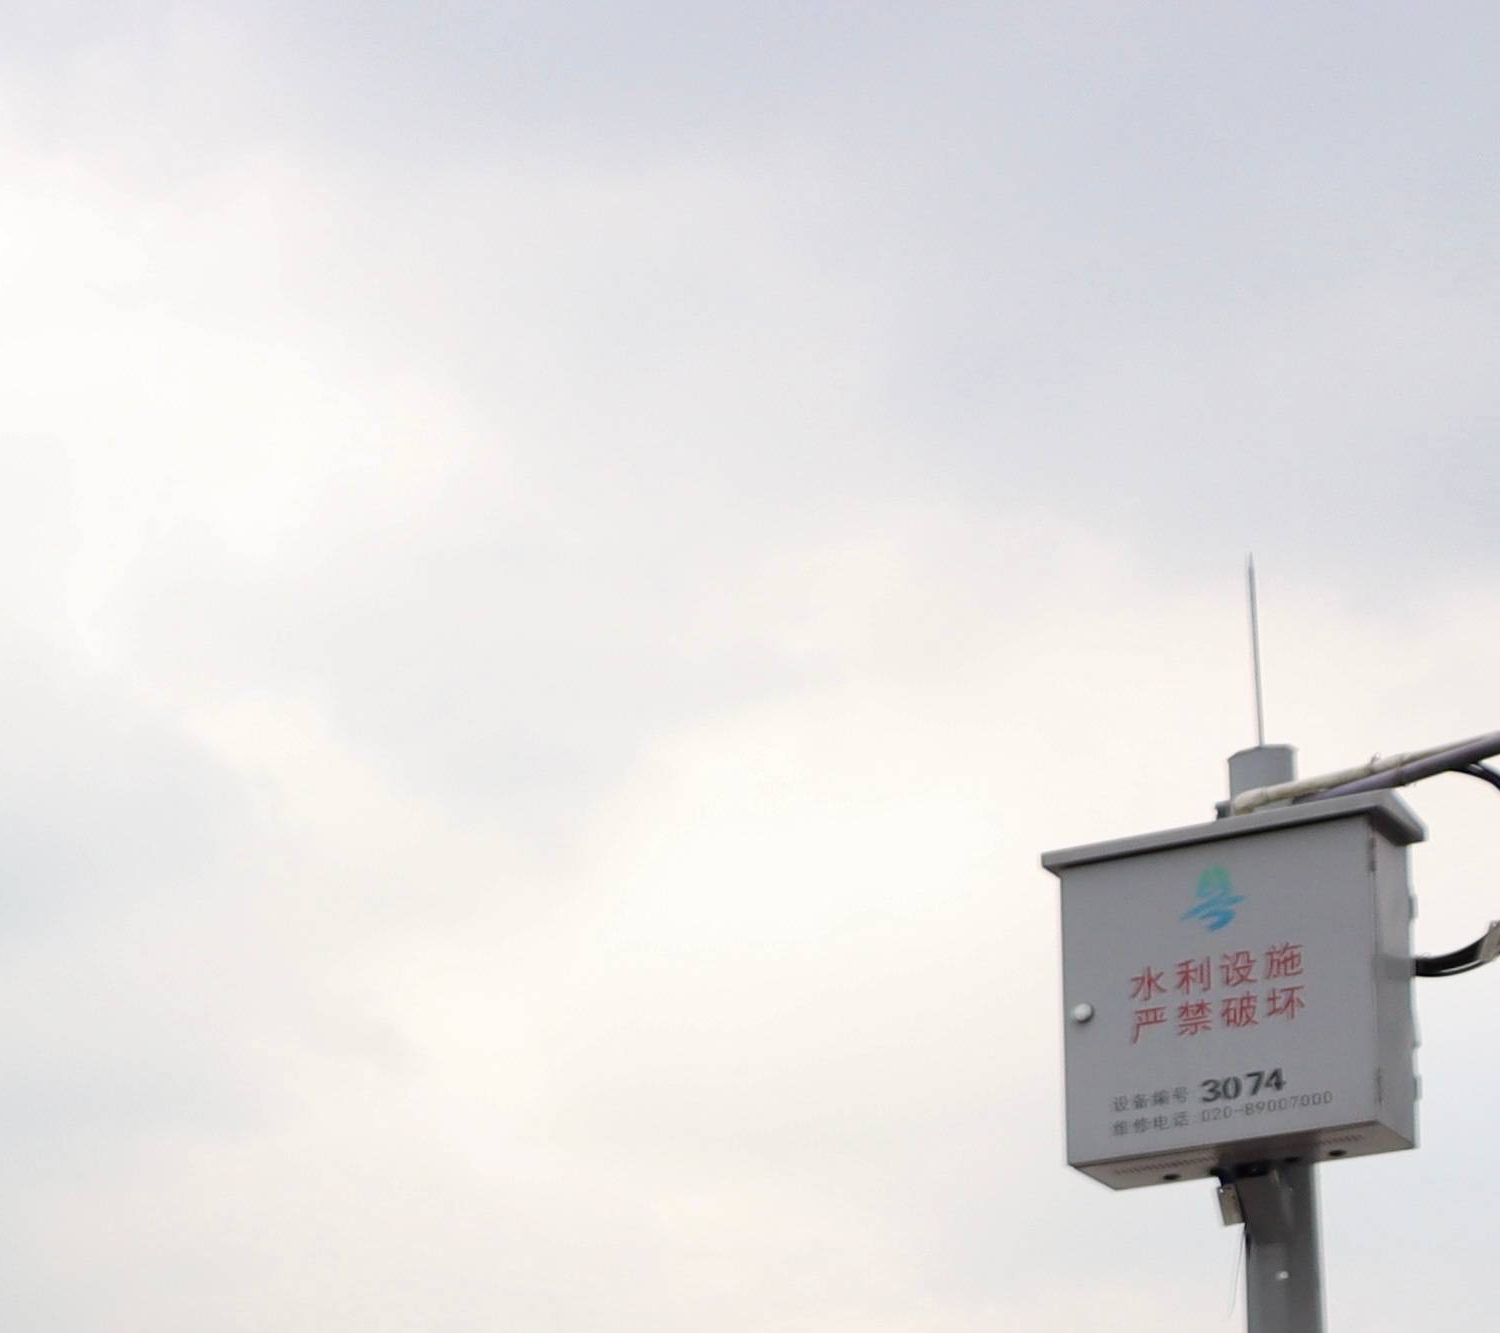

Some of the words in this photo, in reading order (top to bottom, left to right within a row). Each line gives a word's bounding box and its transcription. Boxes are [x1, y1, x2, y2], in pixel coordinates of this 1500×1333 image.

[1130, 941, 1303, 1002] 水利设施
[1130, 984, 1307, 1045] 严禁破坏
[1201, 1067, 1287, 1103] 3074
